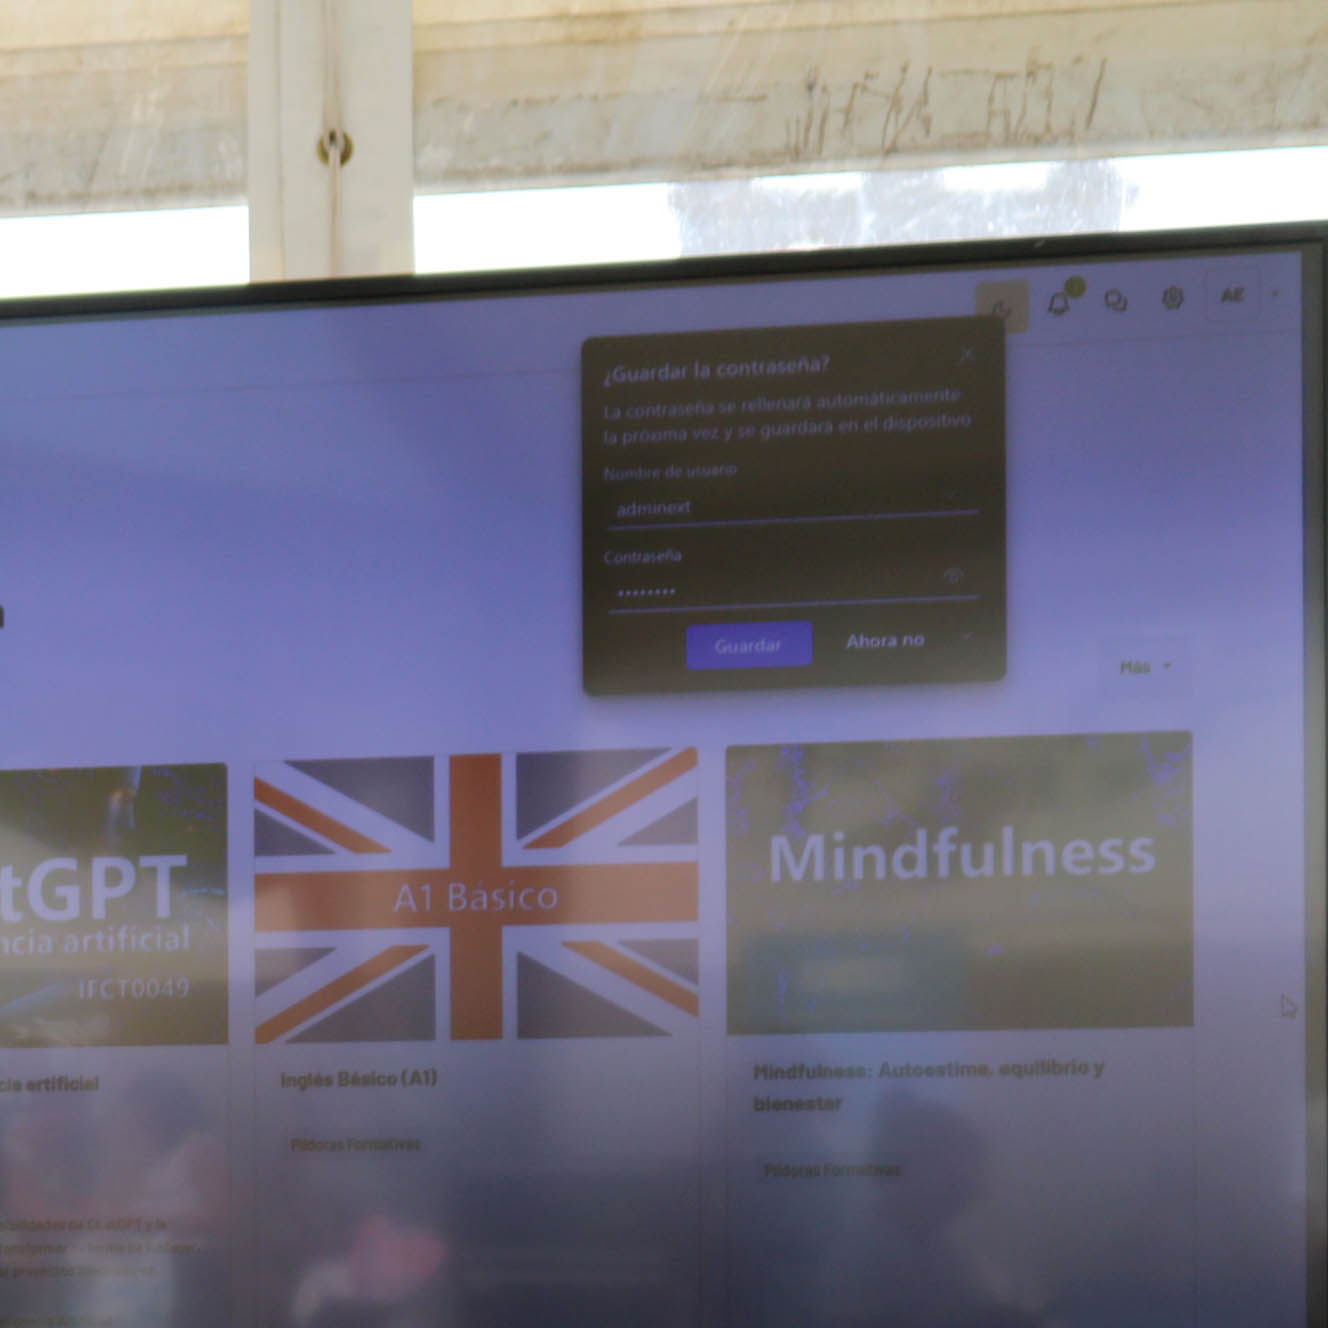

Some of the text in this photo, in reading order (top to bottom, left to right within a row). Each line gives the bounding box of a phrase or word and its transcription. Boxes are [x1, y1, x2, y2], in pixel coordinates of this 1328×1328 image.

[602, 353, 831, 389] ¿Guardar la contraseña?
[625, 400, 714, 420] contraseña
[846, 633, 925, 649] Ahora no
[770, 825, 1157, 883] Mindfulness
[393, 880, 558, 913] A1 Básico
[64, 922, 191, 953] artificial
[79, 976, 189, 1000] IFCT0049
[280, 1066, 438, 1091] Inglés Básico (A1)
[999, 1058, 1090, 1080] equilibrio
[1094, 1060, 1105, 1079] y
[26, 1075, 99, 1094] artificial
